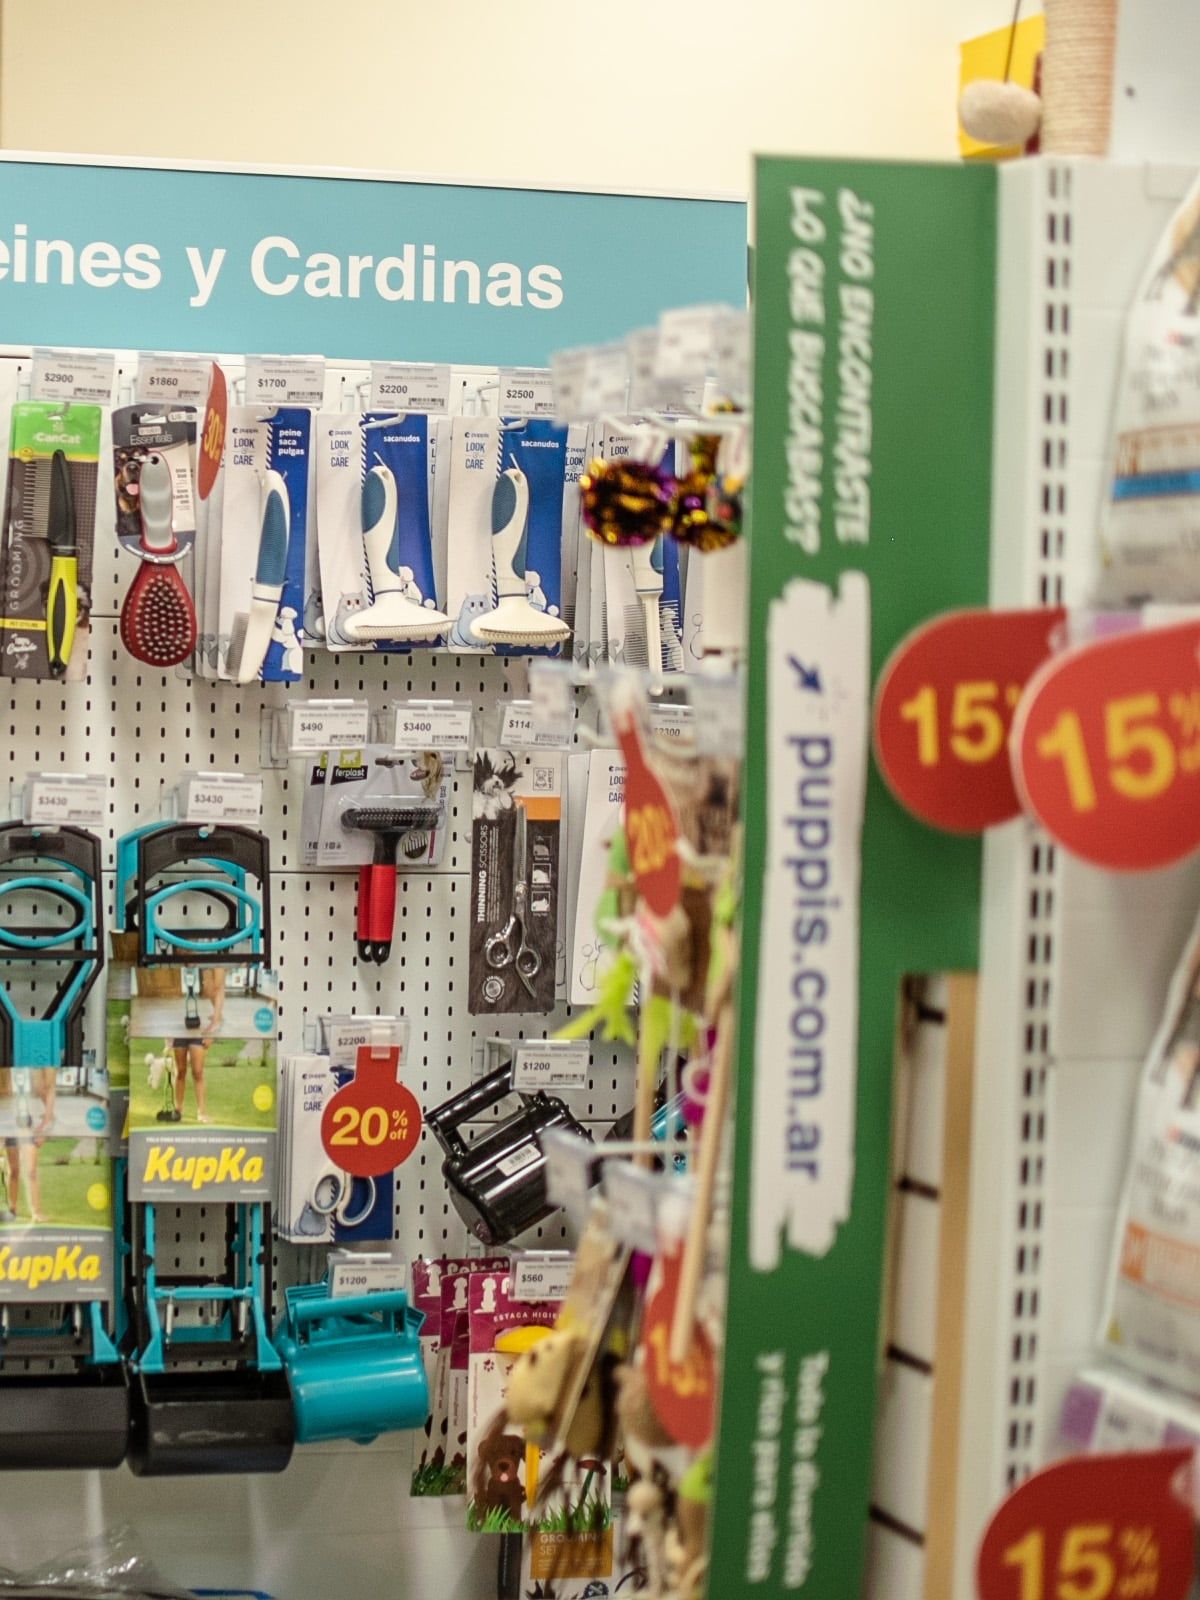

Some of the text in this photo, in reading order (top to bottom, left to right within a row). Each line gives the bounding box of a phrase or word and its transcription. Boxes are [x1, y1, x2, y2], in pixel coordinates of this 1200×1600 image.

[788, 186, 827, 243] LO
[187, 246, 226, 307] y
[250, 235, 565, 310] Cardinas
[786, 246, 827, 326] QUE
[43, 372, 75, 384] $2900
[149, 376, 179, 387] $1860
[257, 378, 287, 389] $1700
[378, 384, 409, 395] $2200
[505, 389, 535, 400] $2500
[833, 283, 876, 545] ENCONTRASTE
[279, 428, 302, 438] peine
[383, 434, 421, 443] sacanudos
[233, 439, 255, 449] LOOK
[330, 440, 350, 450] LOOK
[465, 442, 486, 453] LOOK
[520, 440, 560, 449] sacanudos
[278, 447, 305, 457] pulgas
[610, 446, 630, 456] LOOK
[233, 454, 255, 466] CARE
[330, 456, 350, 467] CARE
[465, 458, 485, 470] CARE
[9, 519, 25, 611] GROOMING
[301, 721, 324, 733] $490
[403, 721, 432, 733] $3400
[508, 718, 533, 730] $114
[335, 766, 365, 781] ferplast
[38, 795, 68, 807] $3430
[193, 793, 224, 805] $3430
[608, 792, 625, 802] CAR
[476, 824, 489, 924] THINNING SCISSORS
[785, 733, 841, 1182] puppis.com.ar
[337, 1035, 366, 1046] $2200
[521, 1060, 551, 1072] $1200
[303, 1085, 323, 1095] LOOK
[303, 1101, 322, 1111] CARE
[388, 1129, 408, 1141] off
[143, 1146, 264, 1189] KupKa
[339, 1275, 367, 1286] $1200
[521, 1273, 543, 1283] $560
[493, 1310, 528, 1323] ESTACA
